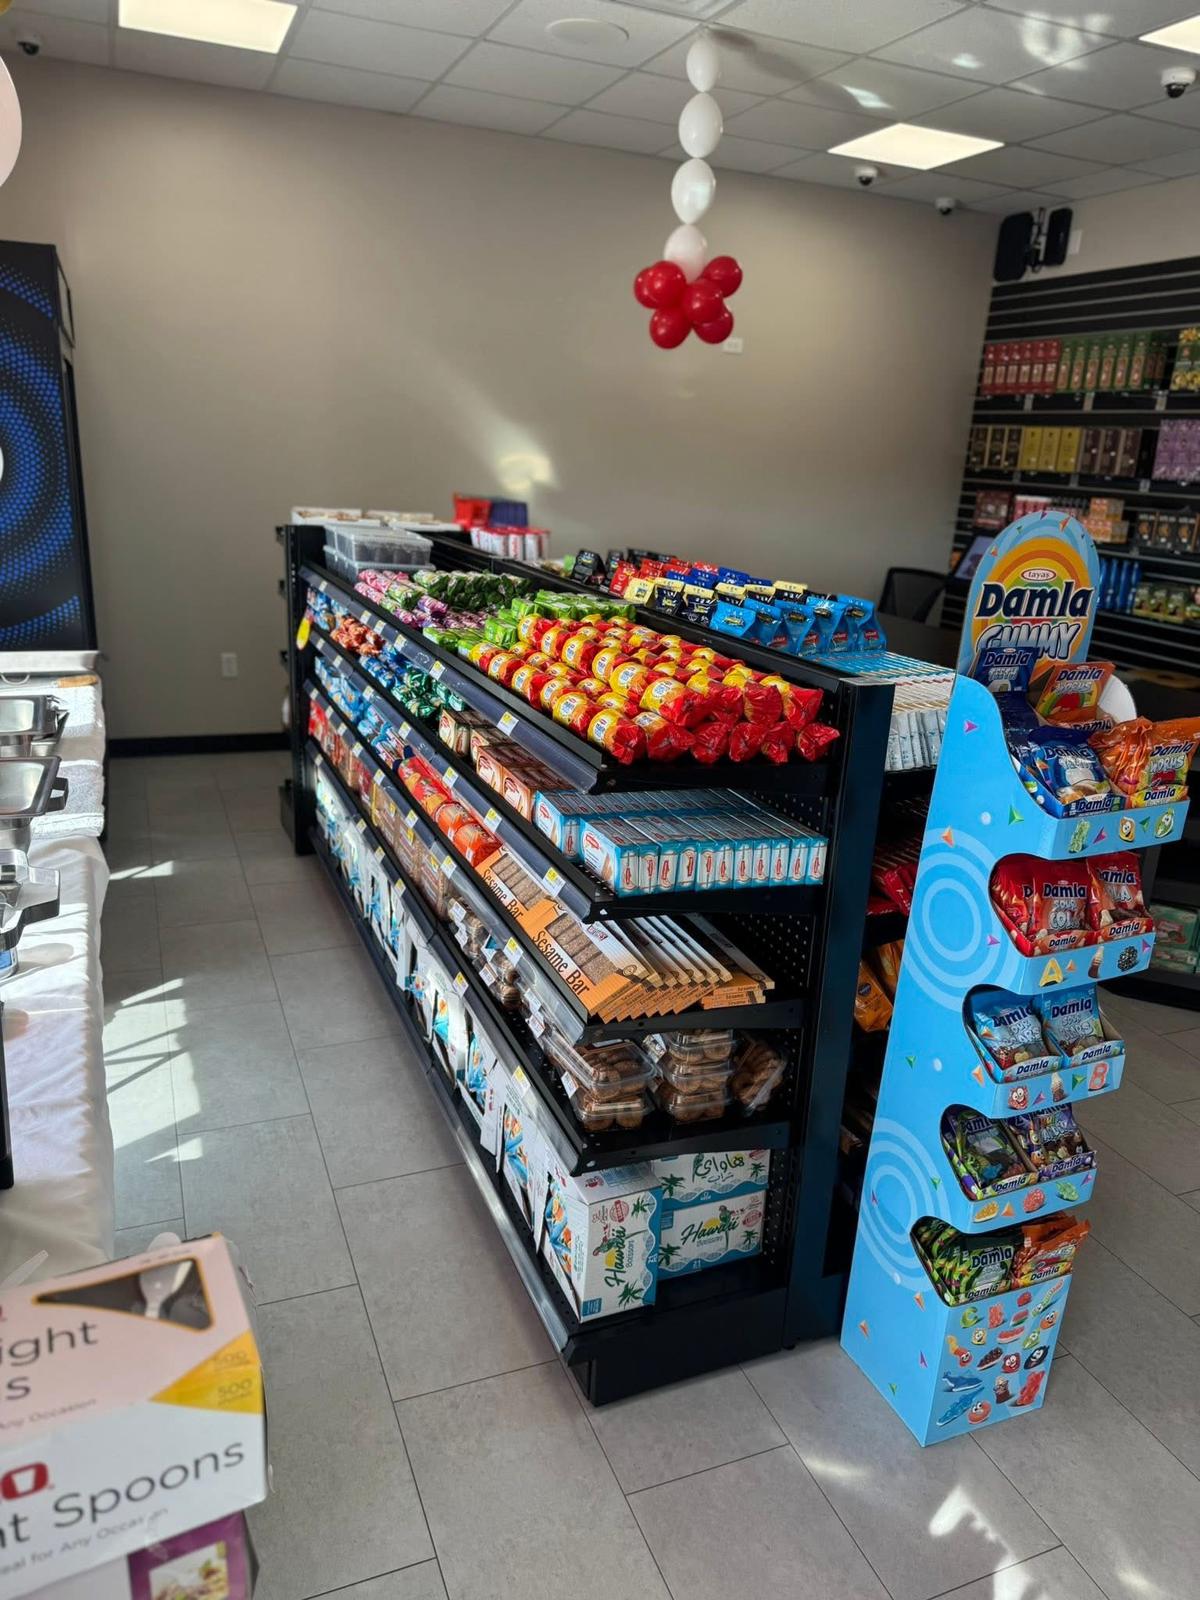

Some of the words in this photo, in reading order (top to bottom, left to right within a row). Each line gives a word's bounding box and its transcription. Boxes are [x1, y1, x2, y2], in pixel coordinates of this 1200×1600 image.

[975, 581, 1094, 617] Damla
[975, 623, 1081, 660] GUMMY
[983, 650, 1032, 667] Damla
[1056, 668, 1104, 681] Damla
[1152, 740, 1194, 757] Damla
[1144, 786, 1177, 801] Damla
[1079, 796, 1113, 812] Damla
[1099, 869, 1137, 884] amla
[482, 869, 508, 902] Sesame
[506, 897, 524, 919] Bar
[1043, 882, 1087, 898] Damla
[1108, 921, 1141, 937] Damla
[1048, 934, 1078, 948] Damla
[532, 930, 569, 974] Sesame
[565, 969, 590, 997] Bar
[1051, 998, 1093, 1019] Damla
[1081, 1043, 1112, 1061] Damla
[1016, 1060, 1050, 1075] Damla
[1051, 1156, 1084, 1173] Damla
[995, 1176, 1028, 1192] Damla
[681, 1216, 740, 1246] Hawaii
[604, 1225, 627, 1288] Hawaii
[971, 1246, 1013, 1269] Damla
[1030, 1263, 1061, 1281] Damla
[966, 1284, 1000, 1300] Damla
[53, 1441, 245, 1529] Spoons
[96, 1508, 169, 1540] Occason
